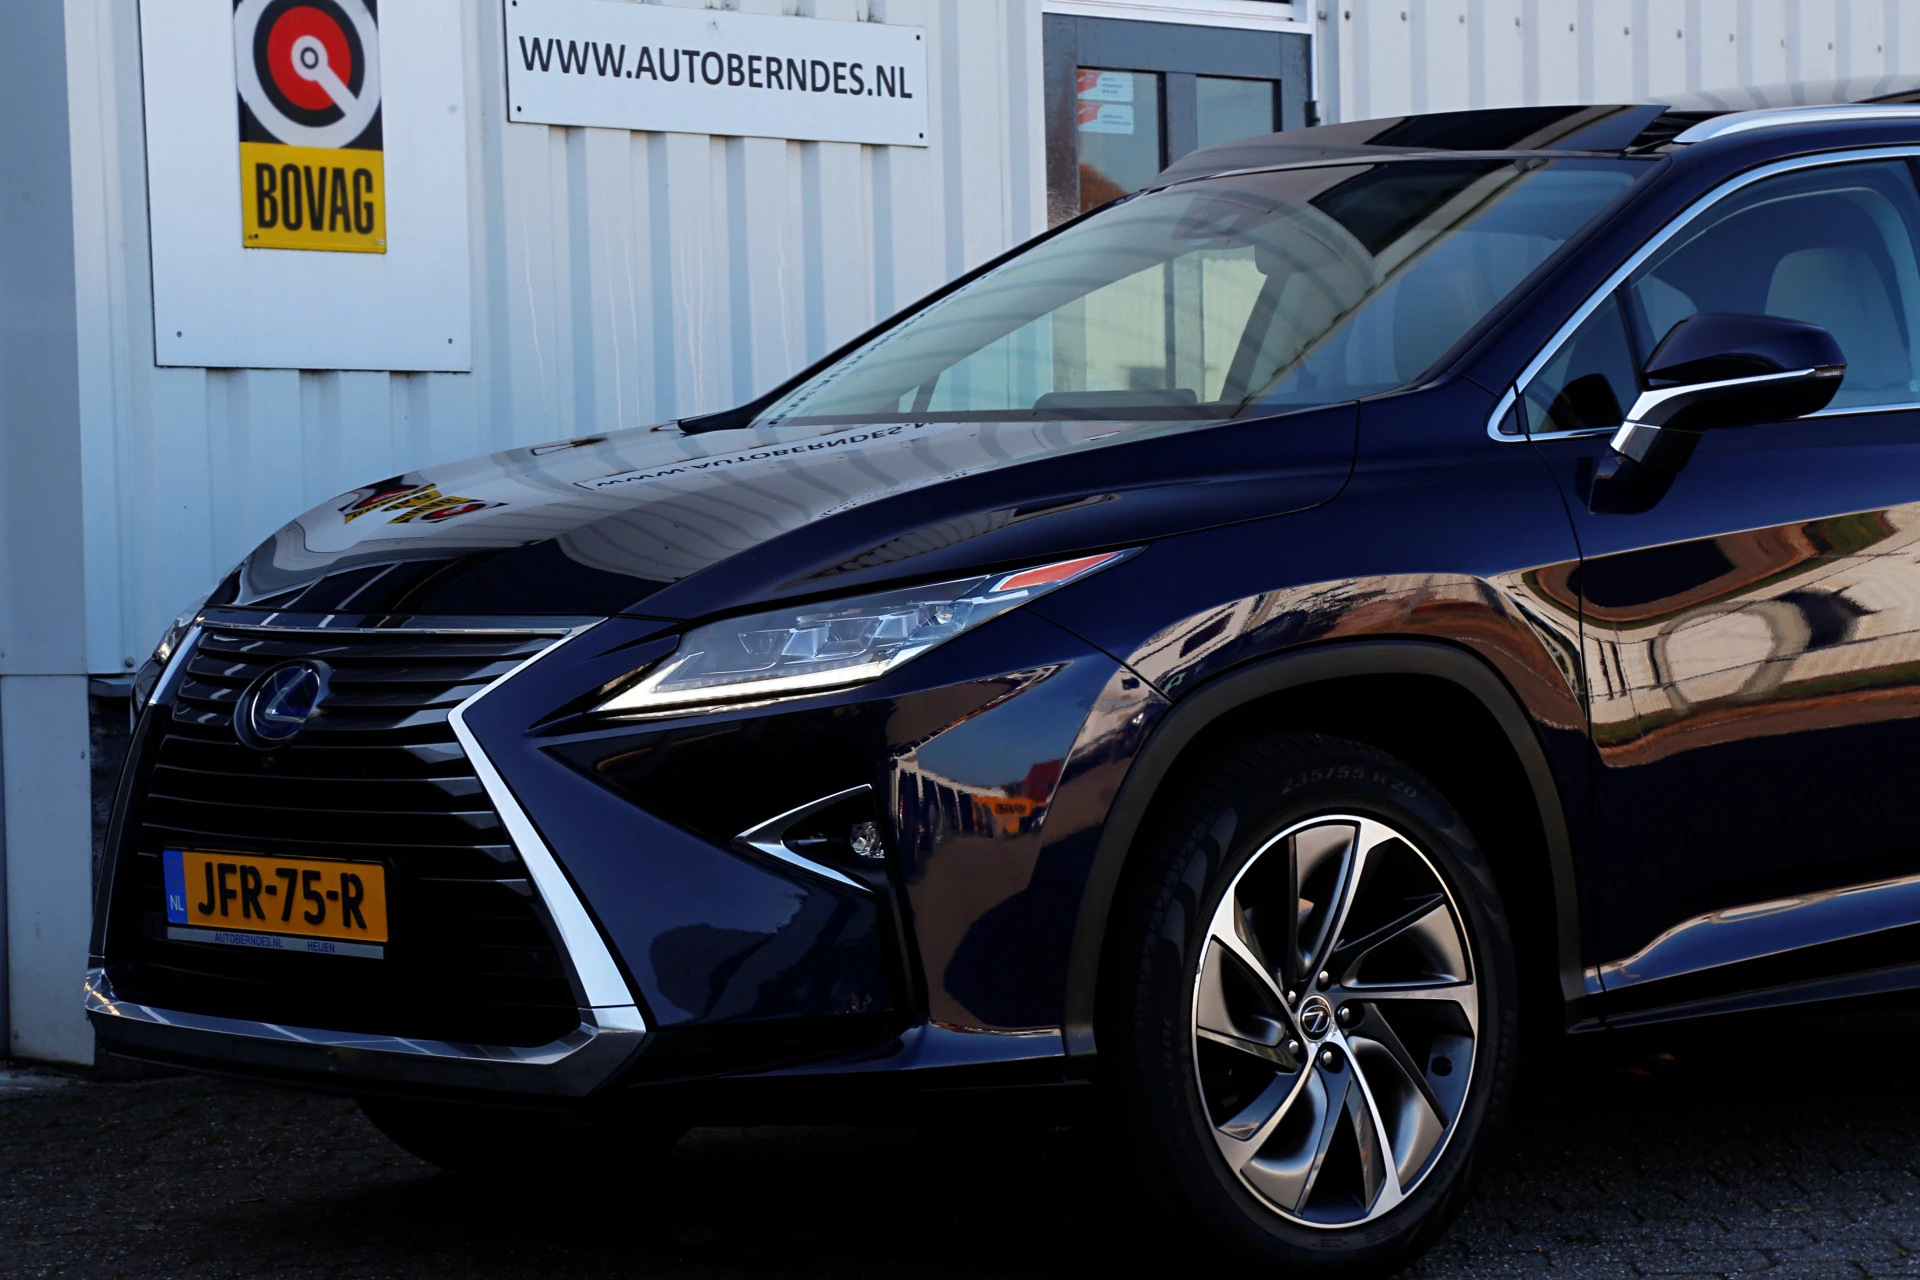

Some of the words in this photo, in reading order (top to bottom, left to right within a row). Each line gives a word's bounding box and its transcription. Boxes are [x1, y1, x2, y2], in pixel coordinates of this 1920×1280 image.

[518, 35, 913, 98] WWW.AUTOBERNDES.NL
[255, 163, 375, 235] BOVAG
[1280, 766, 1366, 796] 235/55
[169, 894, 185, 912] NL
[197, 861, 368, 930] JFR-75-R
[214, 931, 284, 949] AUTOBERNDES.NL
[307, 940, 336, 954] HEIJEN
